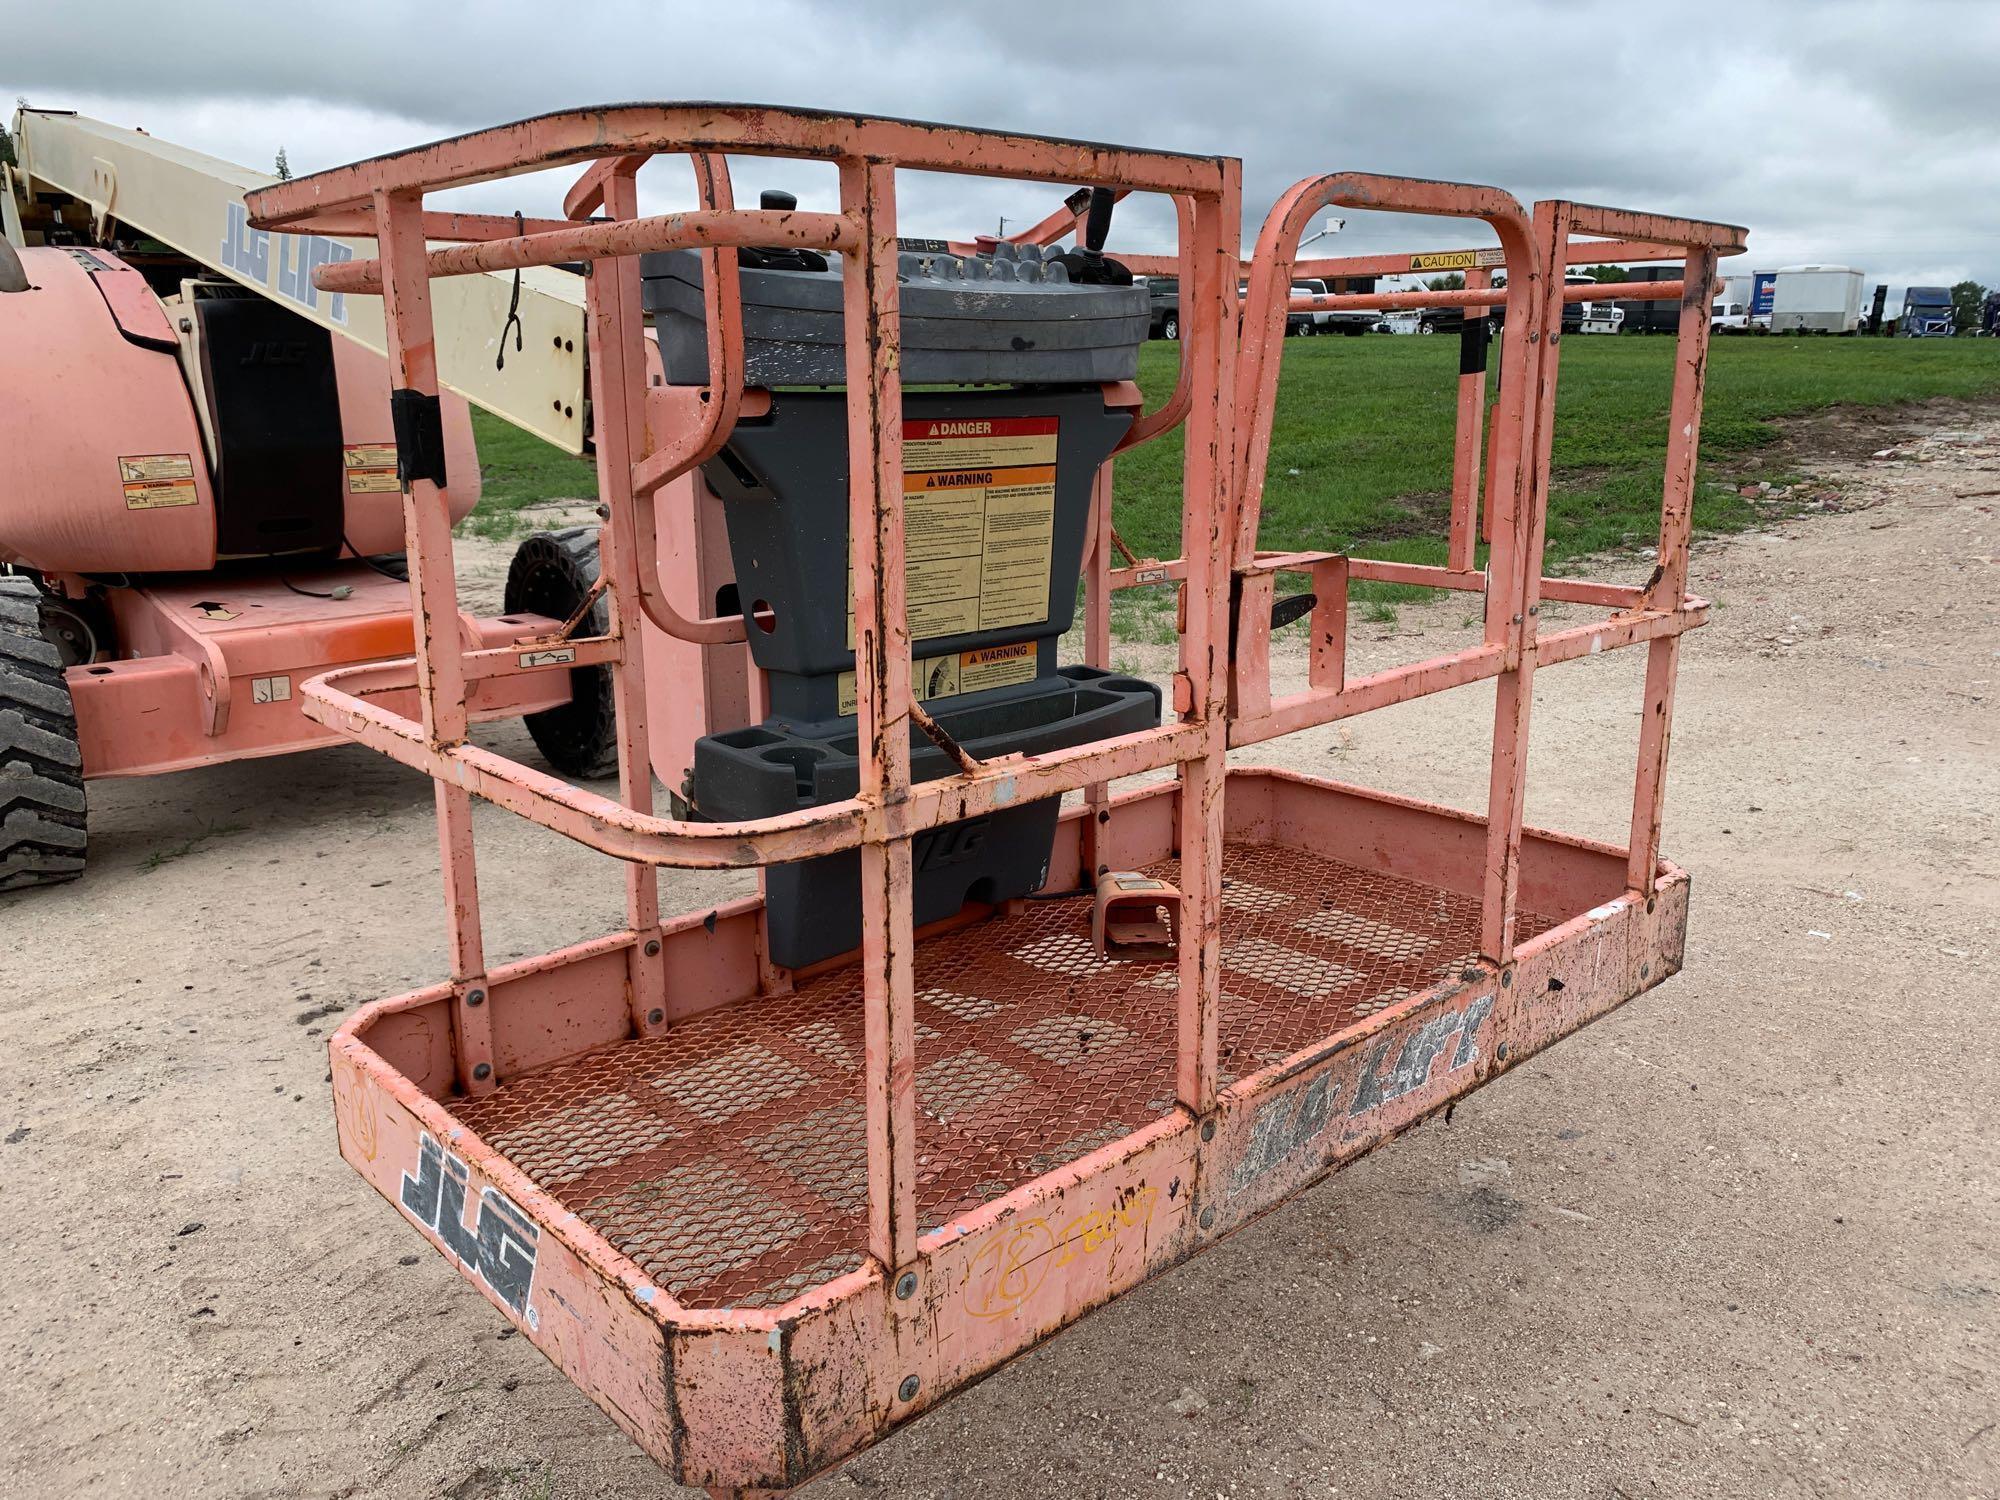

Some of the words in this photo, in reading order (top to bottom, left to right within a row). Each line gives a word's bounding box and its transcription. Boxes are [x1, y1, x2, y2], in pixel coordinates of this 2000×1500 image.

[221, 201, 270, 288] JLG
[1423, 254, 1473, 268] CAUTION
[940, 422, 992, 435] DANGER
[938, 473, 992, 487] WARNING
[980, 645, 1028, 662] WARNING
[400, 1130, 541, 1321] JLG
